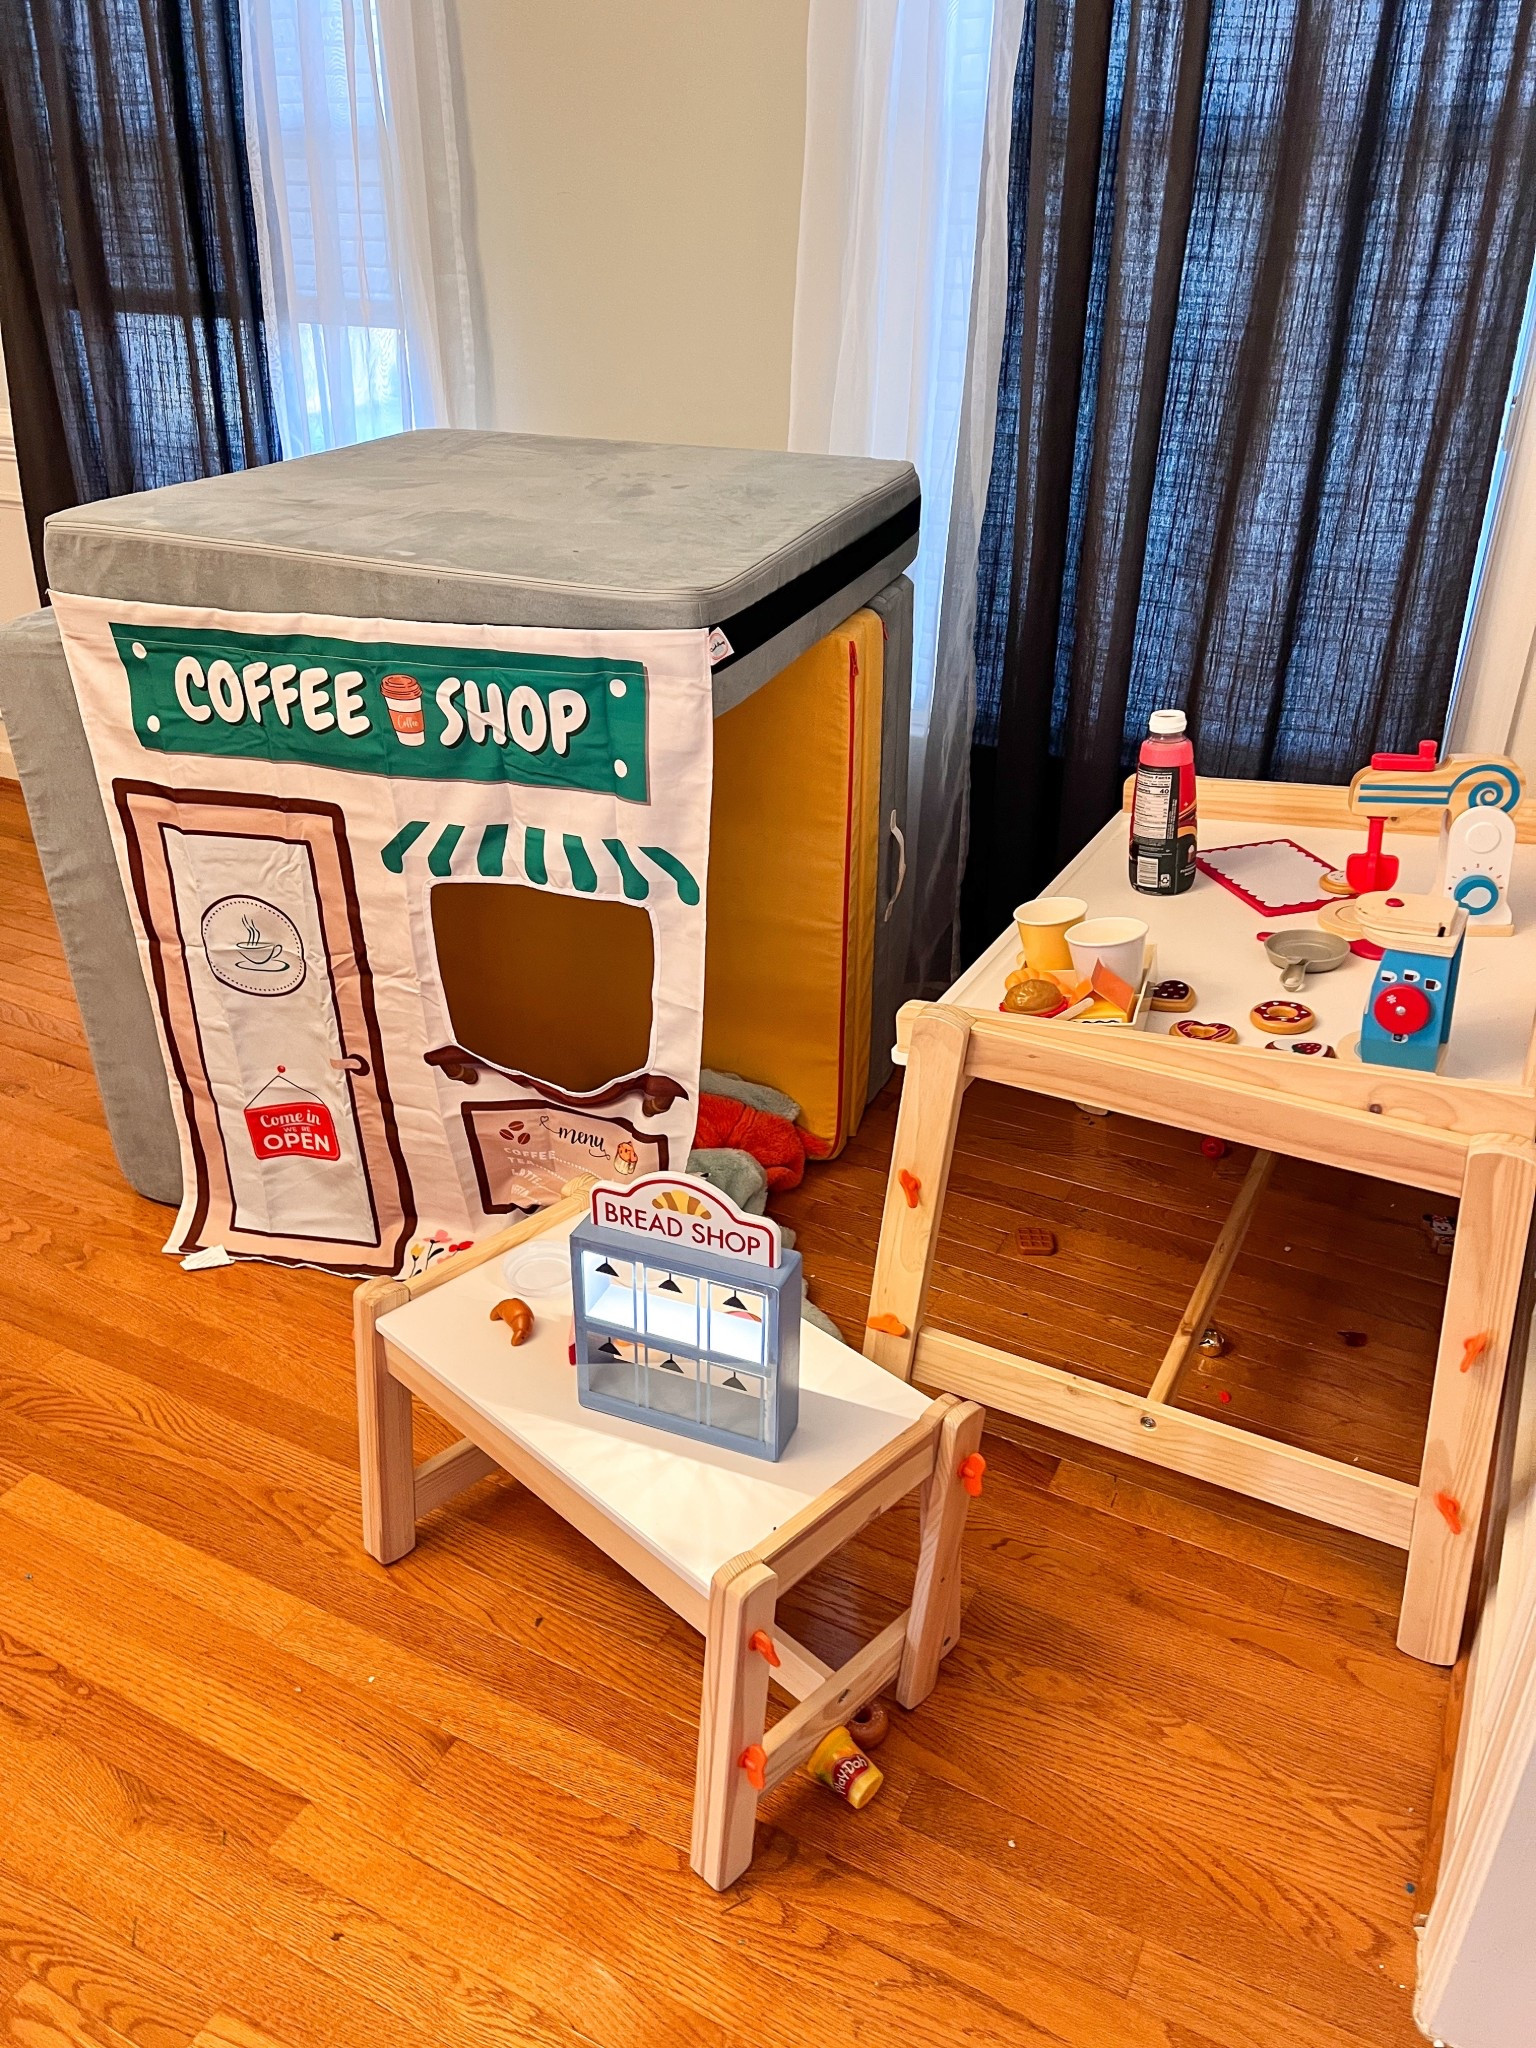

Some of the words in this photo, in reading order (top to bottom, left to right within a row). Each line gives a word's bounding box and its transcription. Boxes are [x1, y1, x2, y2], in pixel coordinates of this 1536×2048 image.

[174, 655, 371, 738] COFFEE
[435, 676, 589, 757] SHOP
[397, 714, 420, 729] Coffee
[260, 1112, 304, 1128] Come
[306, 1109, 321, 1125] in
[263, 1132, 331, 1152] OPEN
[557, 1127, 604, 1151] menu
[504, 1147, 556, 1160] COFFEE
[507, 1156, 535, 1166] TEA
[511, 1168, 543, 1186] LATTE
[604, 1201, 683, 1238] BREAD
[691, 1222, 761, 1256] SHOP
